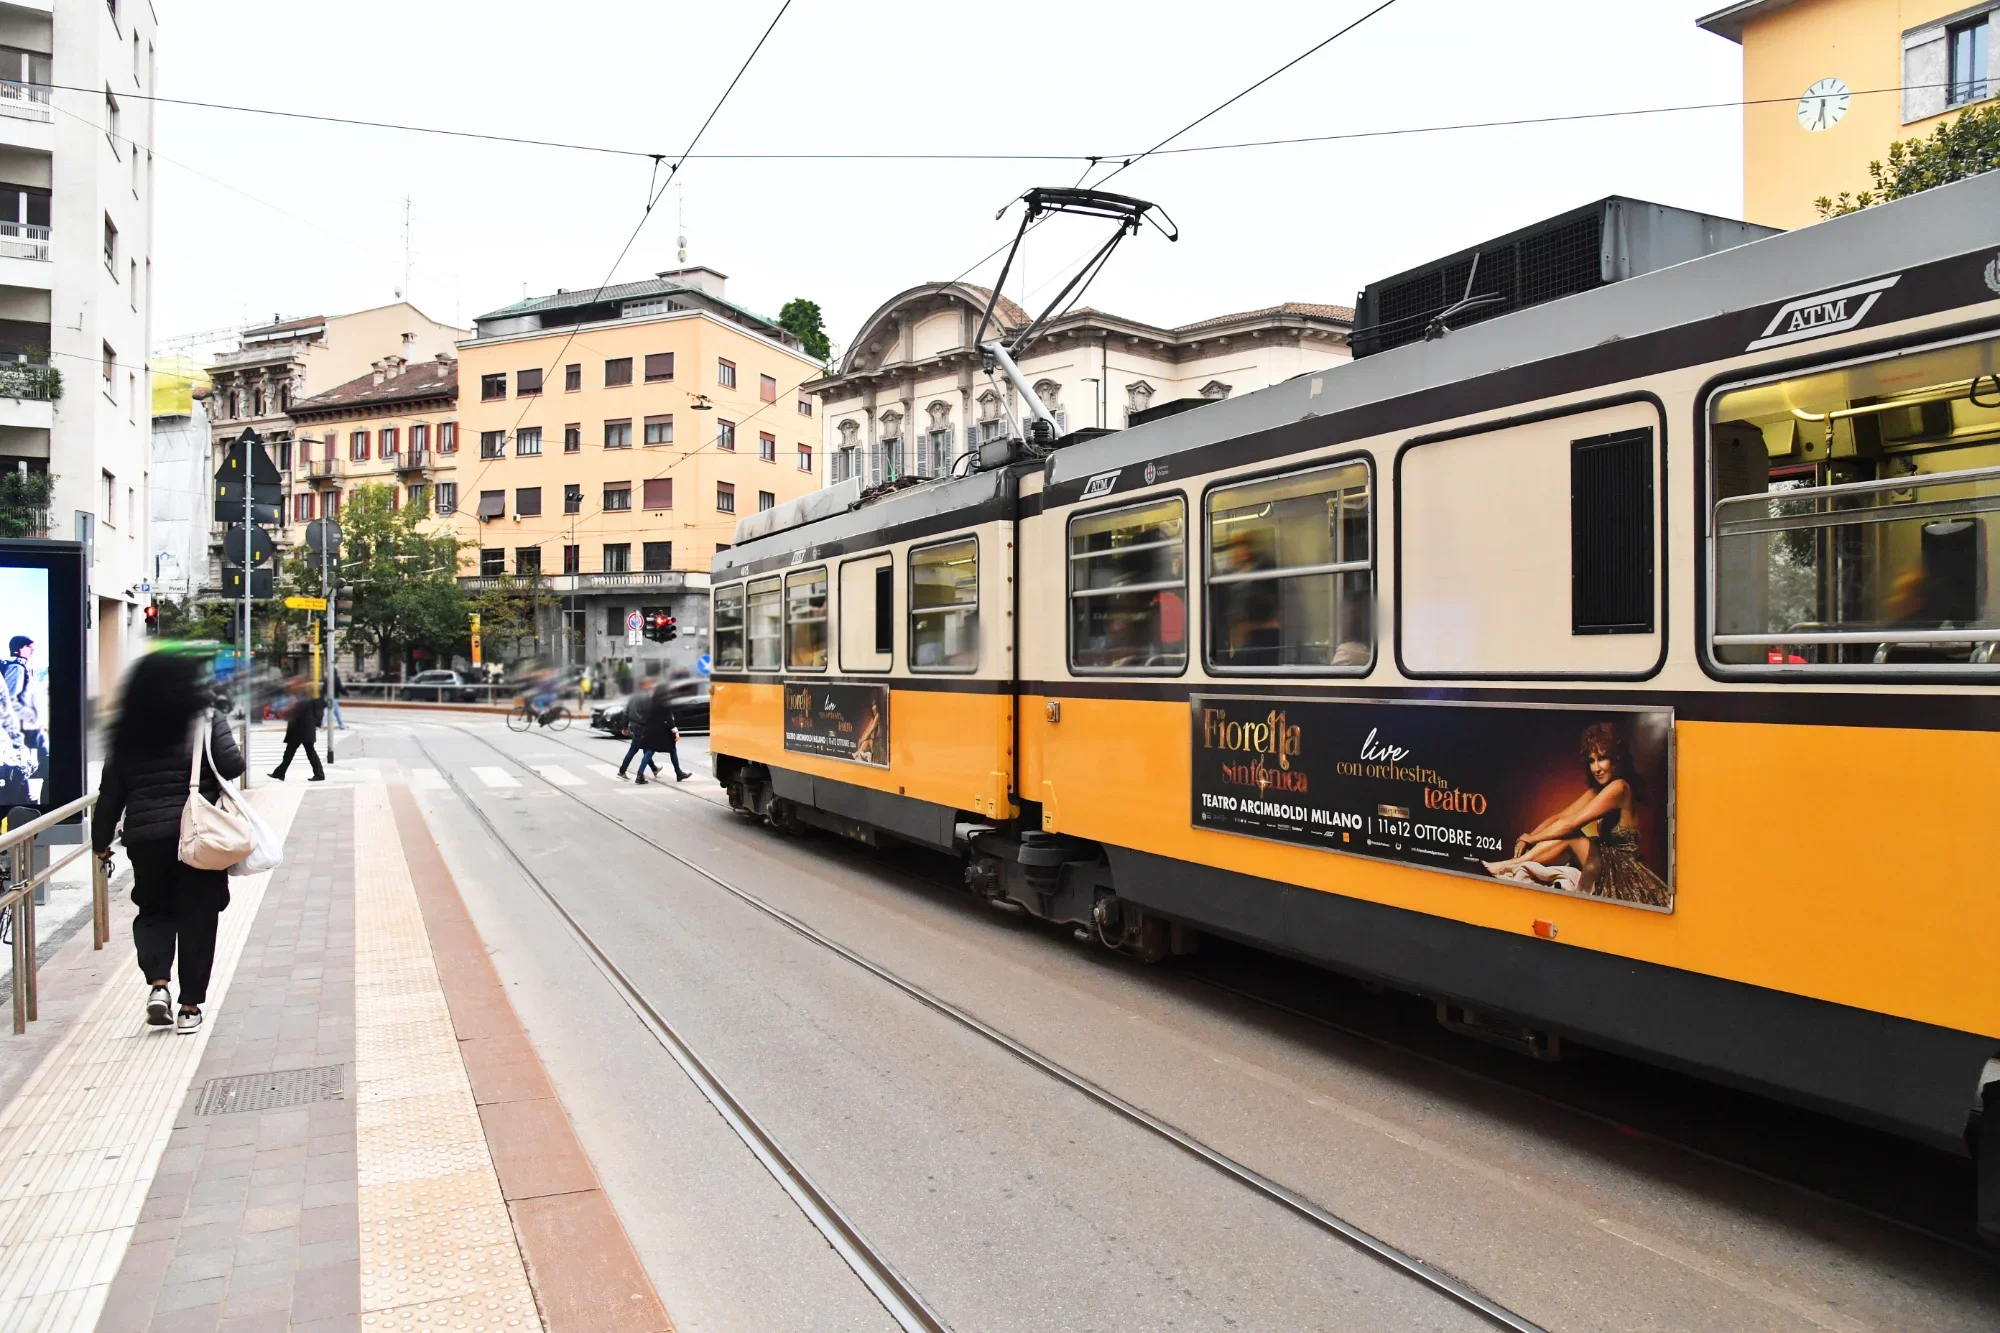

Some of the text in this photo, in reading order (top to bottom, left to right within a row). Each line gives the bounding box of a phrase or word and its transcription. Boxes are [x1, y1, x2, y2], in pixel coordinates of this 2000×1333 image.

[1788, 299, 1848, 332] ATM
[1090, 478, 1108, 492] ATM
[1204, 708, 1301, 771] Fiorella
[1360, 727, 1410, 762] live
[1222, 753, 1309, 799] sinfonica
[1336, 758, 1448, 789] con orchestra in
[1424, 786, 1487, 815] teatro
[1202, 793, 1238, 811] TEATRO
[1240, 798, 1308, 822] ARCIMBOLDI
[1311, 808, 1363, 830] MILANO
[1414, 823, 1472, 847] OTTOBRE
[1476, 835, 1502, 851] 2024
